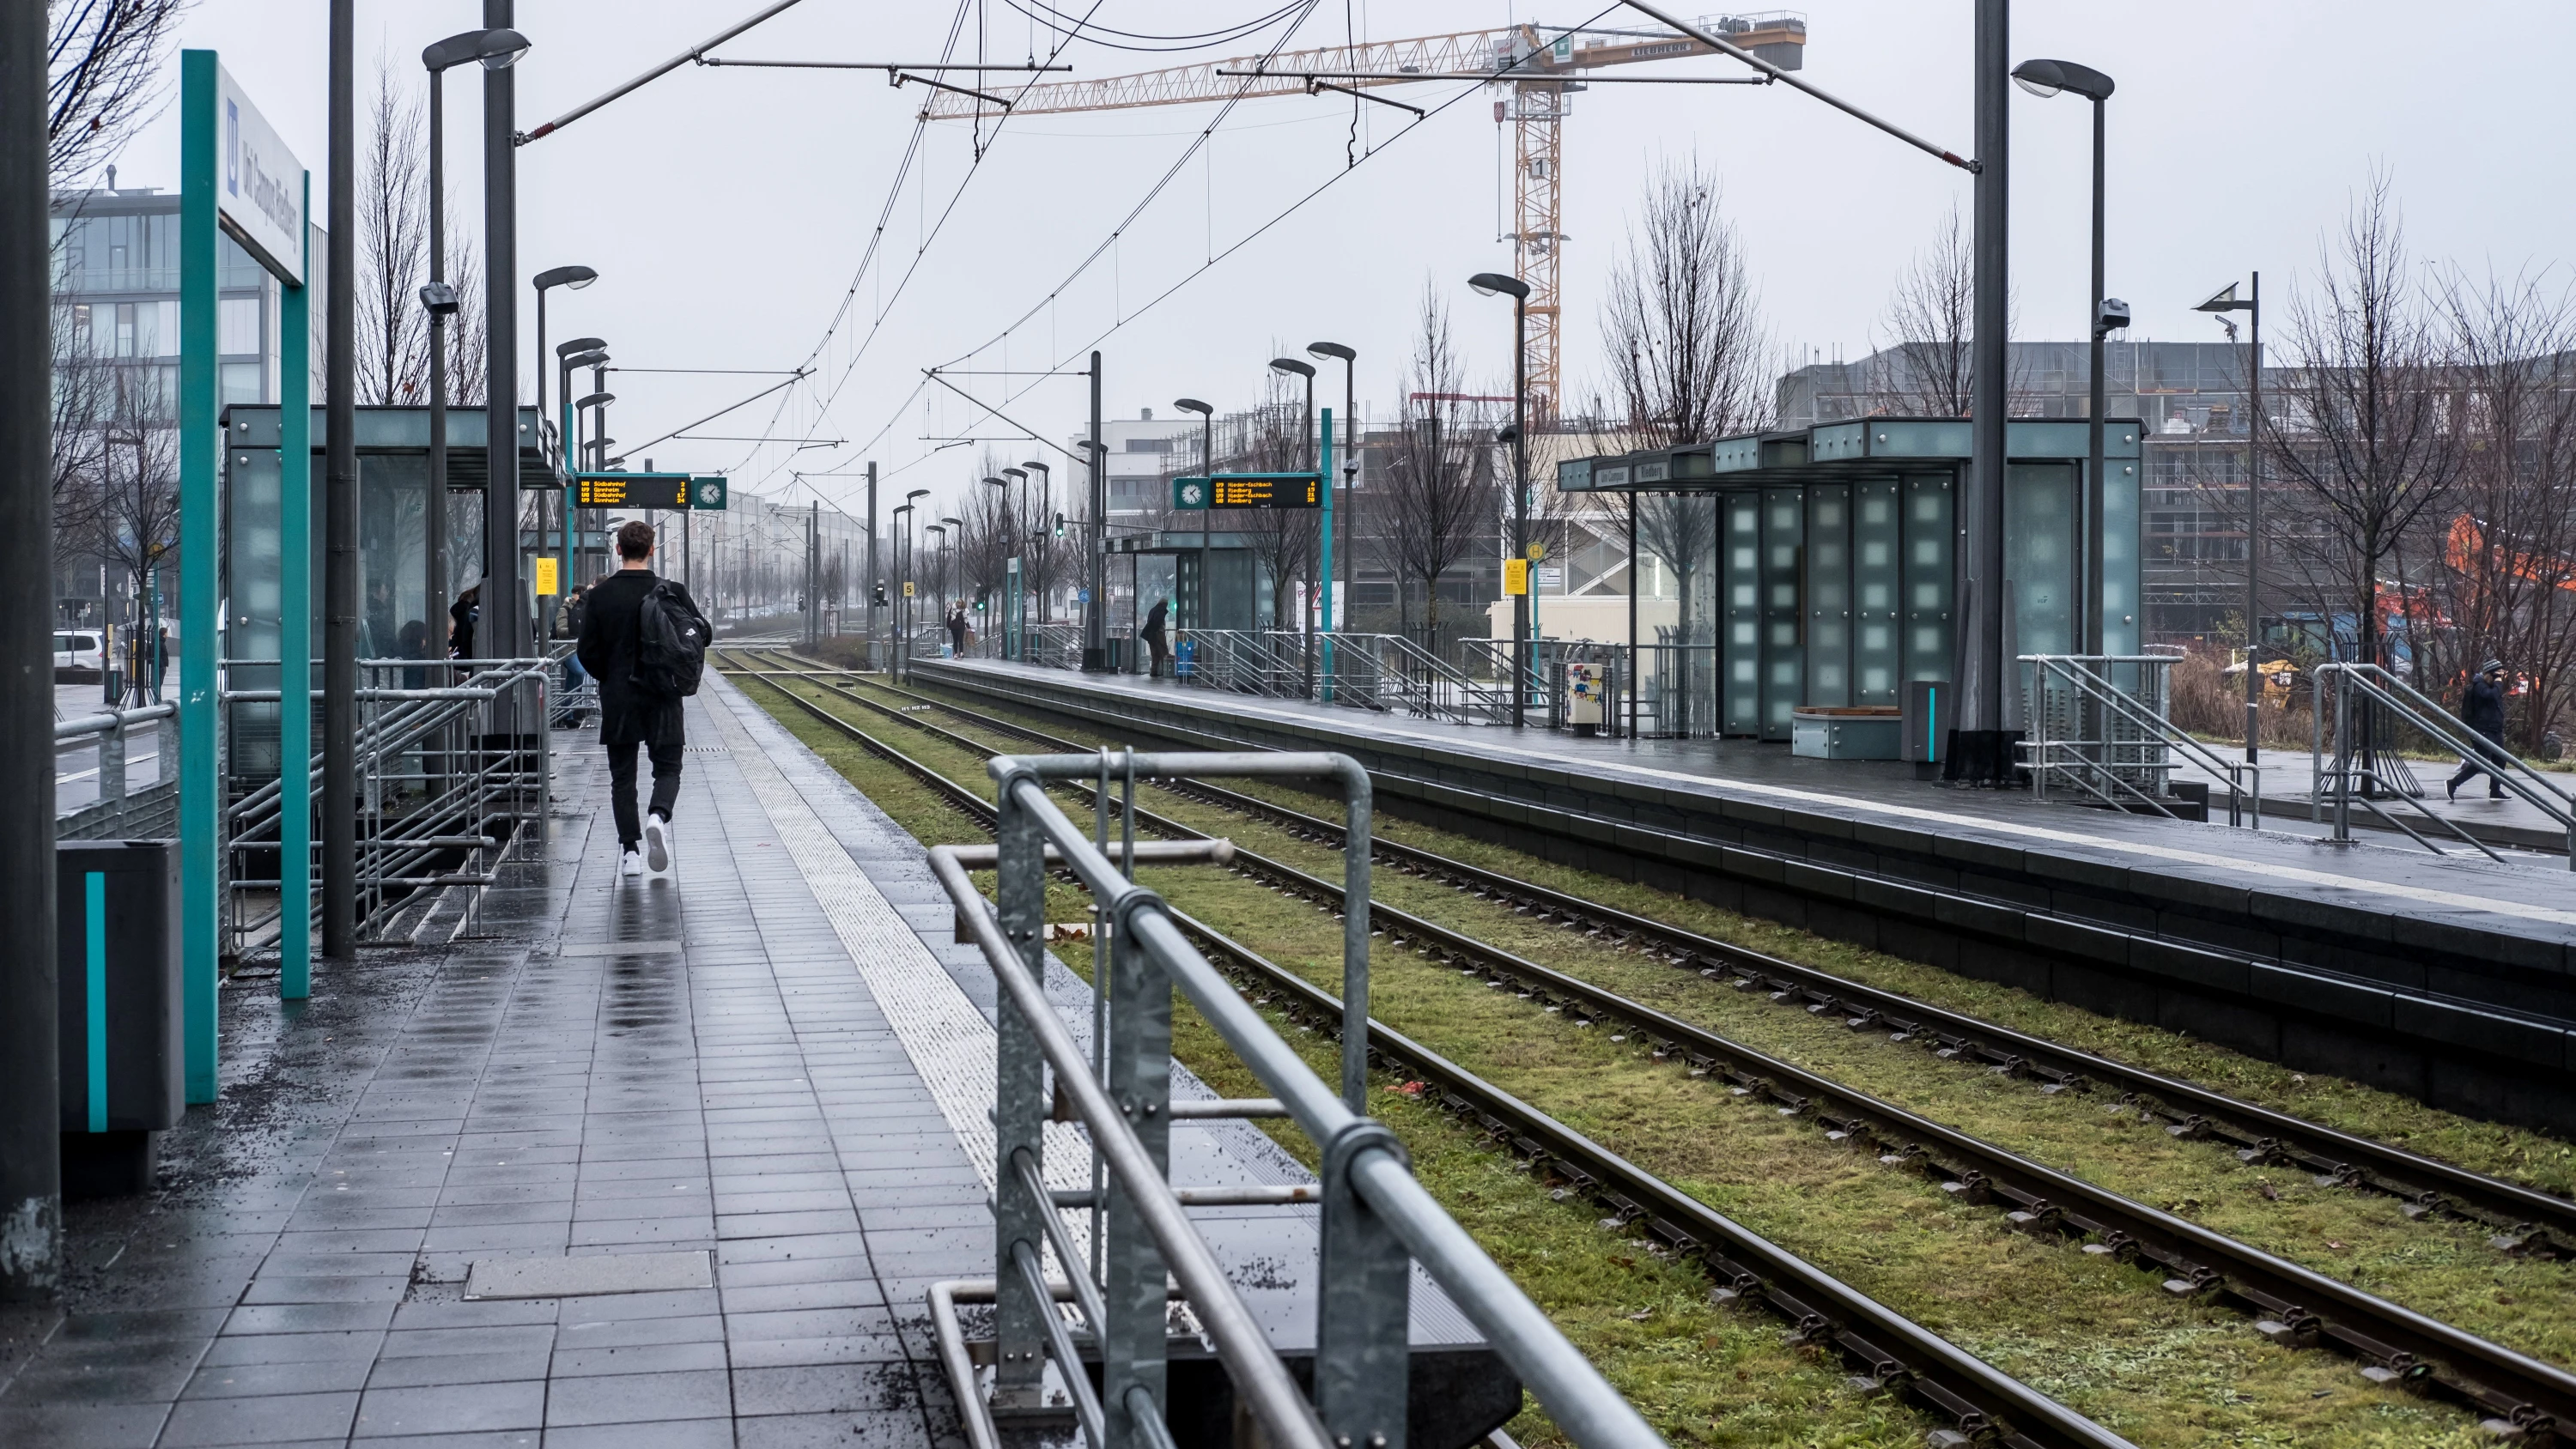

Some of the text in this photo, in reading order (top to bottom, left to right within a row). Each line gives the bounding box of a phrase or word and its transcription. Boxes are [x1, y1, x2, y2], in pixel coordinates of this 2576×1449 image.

[1634, 43, 1688, 56] LIEBHERR
[243, 140, 253, 199] Uni
[254, 153, 275, 227] Campus
[276, 177, 297, 255] Riedberg
[1533, 547, 1539, 556] H
[906, 585, 912, 593] 5
